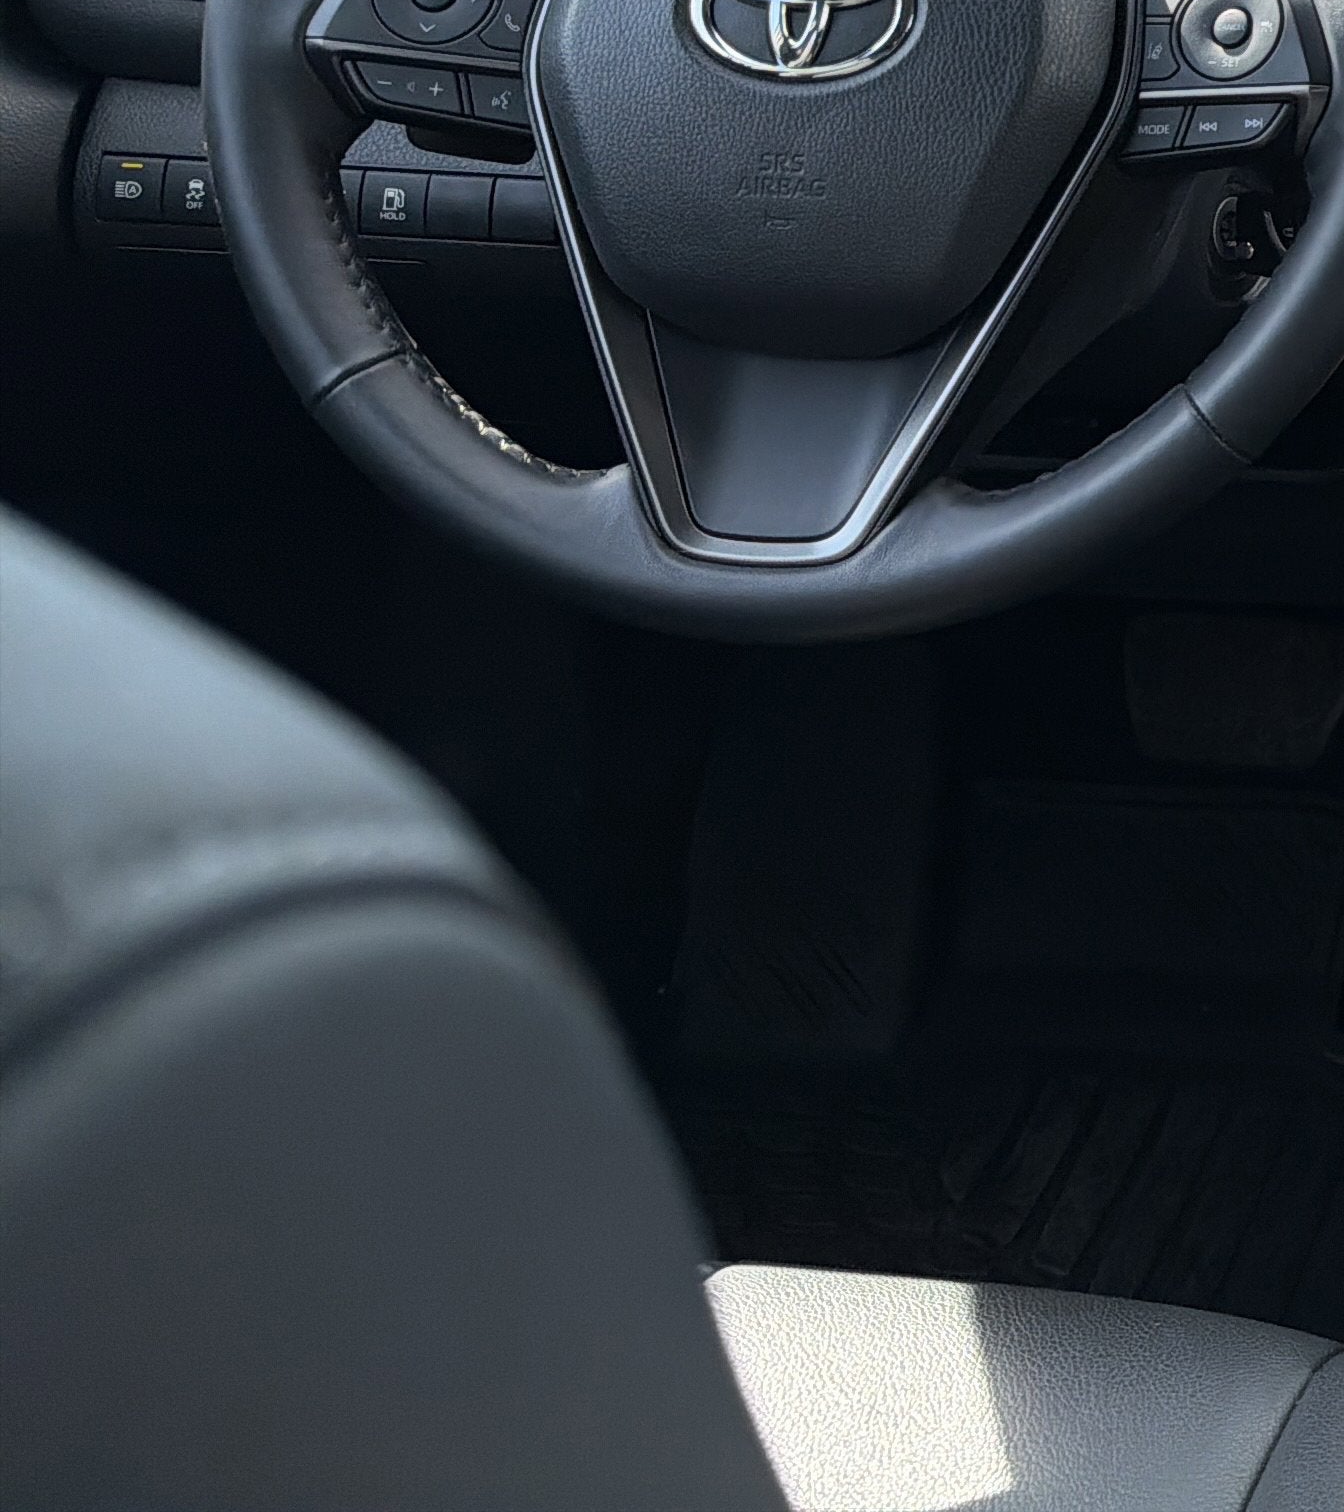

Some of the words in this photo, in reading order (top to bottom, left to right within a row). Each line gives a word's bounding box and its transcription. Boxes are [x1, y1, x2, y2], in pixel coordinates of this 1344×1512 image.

[1221, 58, 1241, 68] SET
[1138, 124, 1170, 135] MODE
[758, 153, 805, 175] SRS
[736, 176, 827, 199] AIRBAG
[186, 200, 204, 210] OFF
[379, 211, 407, 221] HOLD
